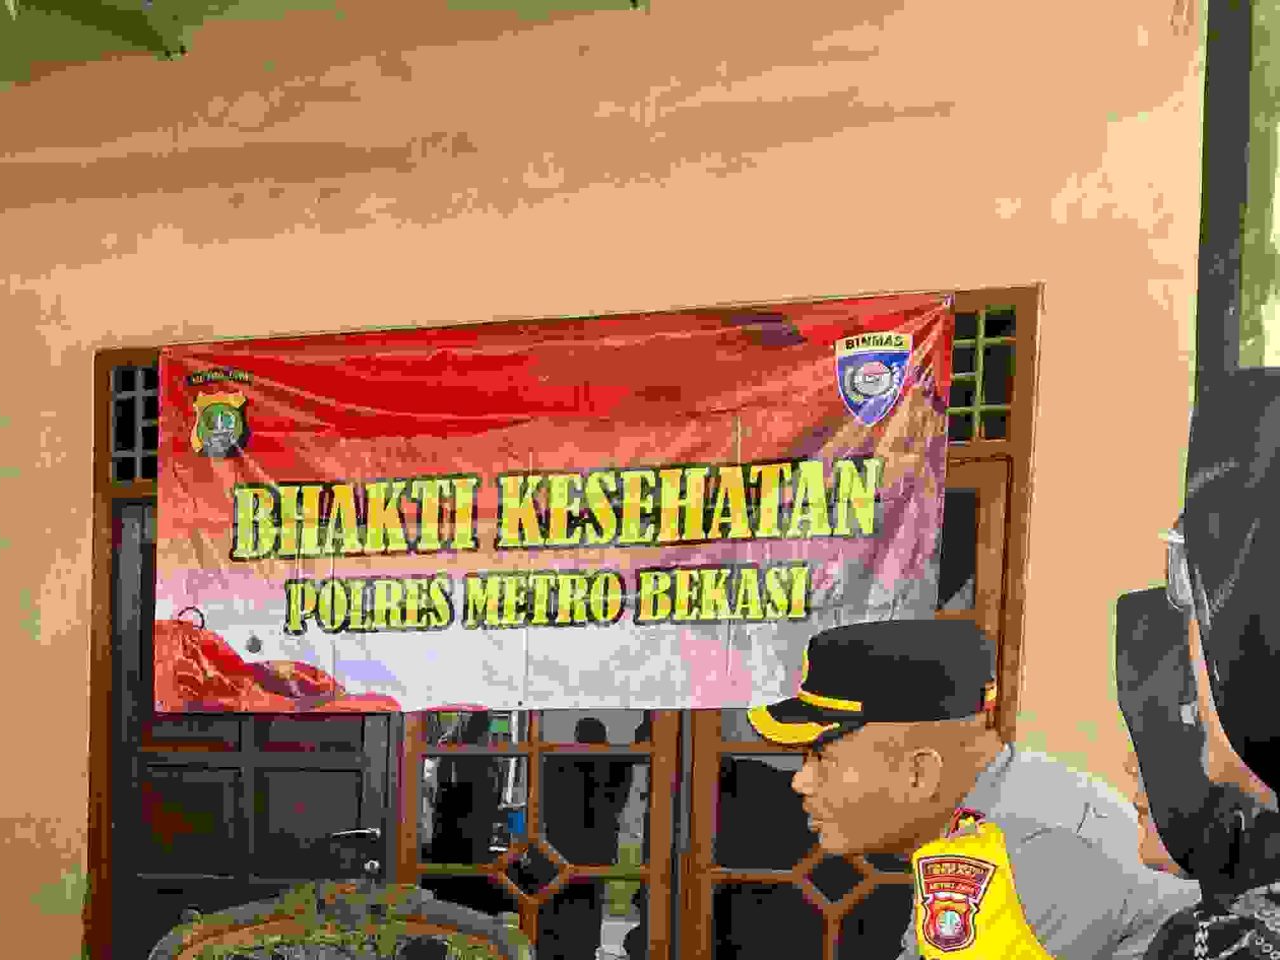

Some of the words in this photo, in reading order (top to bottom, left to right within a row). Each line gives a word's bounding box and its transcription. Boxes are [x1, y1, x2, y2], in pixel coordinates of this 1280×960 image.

[845, 334, 904, 350] BINMAS
[231, 472, 480, 560] BHAKTI
[495, 455, 884, 549] KESEHATAN
[284, 571, 455, 635] POLRES
[461, 569, 626, 629] METRO
[634, 561, 811, 624] BEKASI
